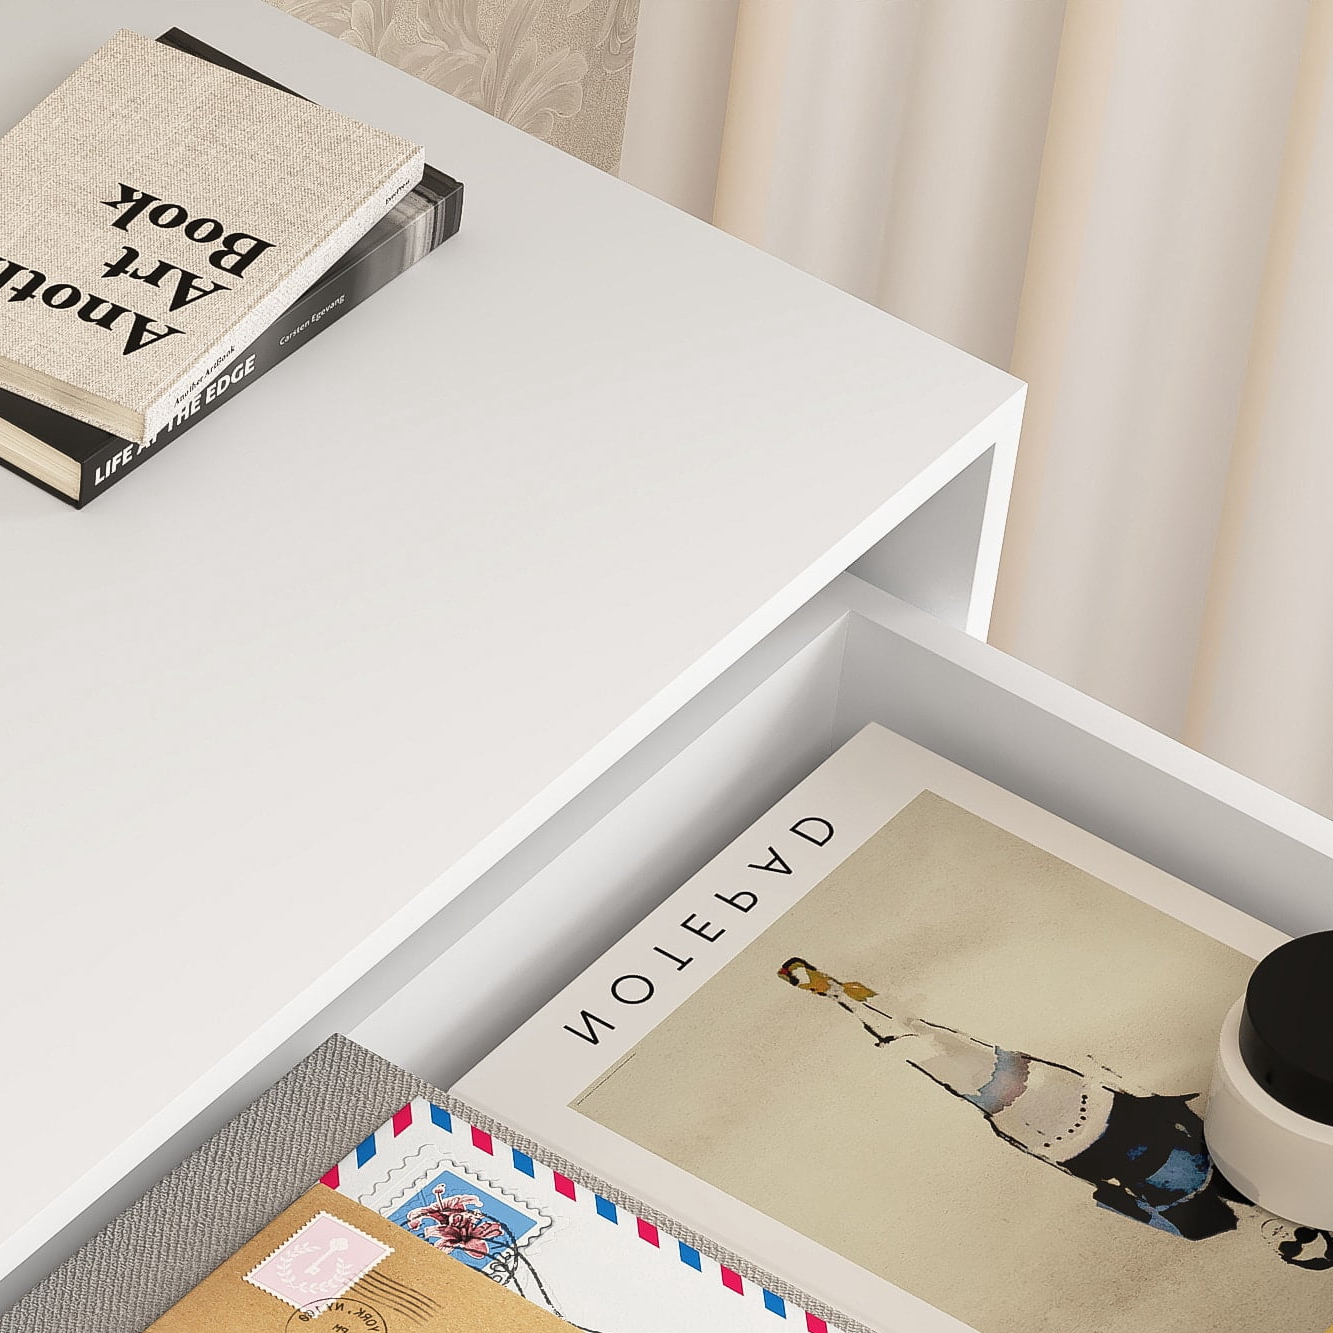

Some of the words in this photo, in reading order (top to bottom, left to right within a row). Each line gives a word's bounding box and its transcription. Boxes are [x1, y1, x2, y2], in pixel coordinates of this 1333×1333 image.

[99, 182, 278, 279] Book
[100, 245, 233, 313] Art
[279, 320, 310, 346] Carsten
[311, 295, 346, 323] Egevang
[95, 443, 134, 487] LIFE
[205, 354, 256, 405] EDGE
[174, 374, 204, 408] Another
